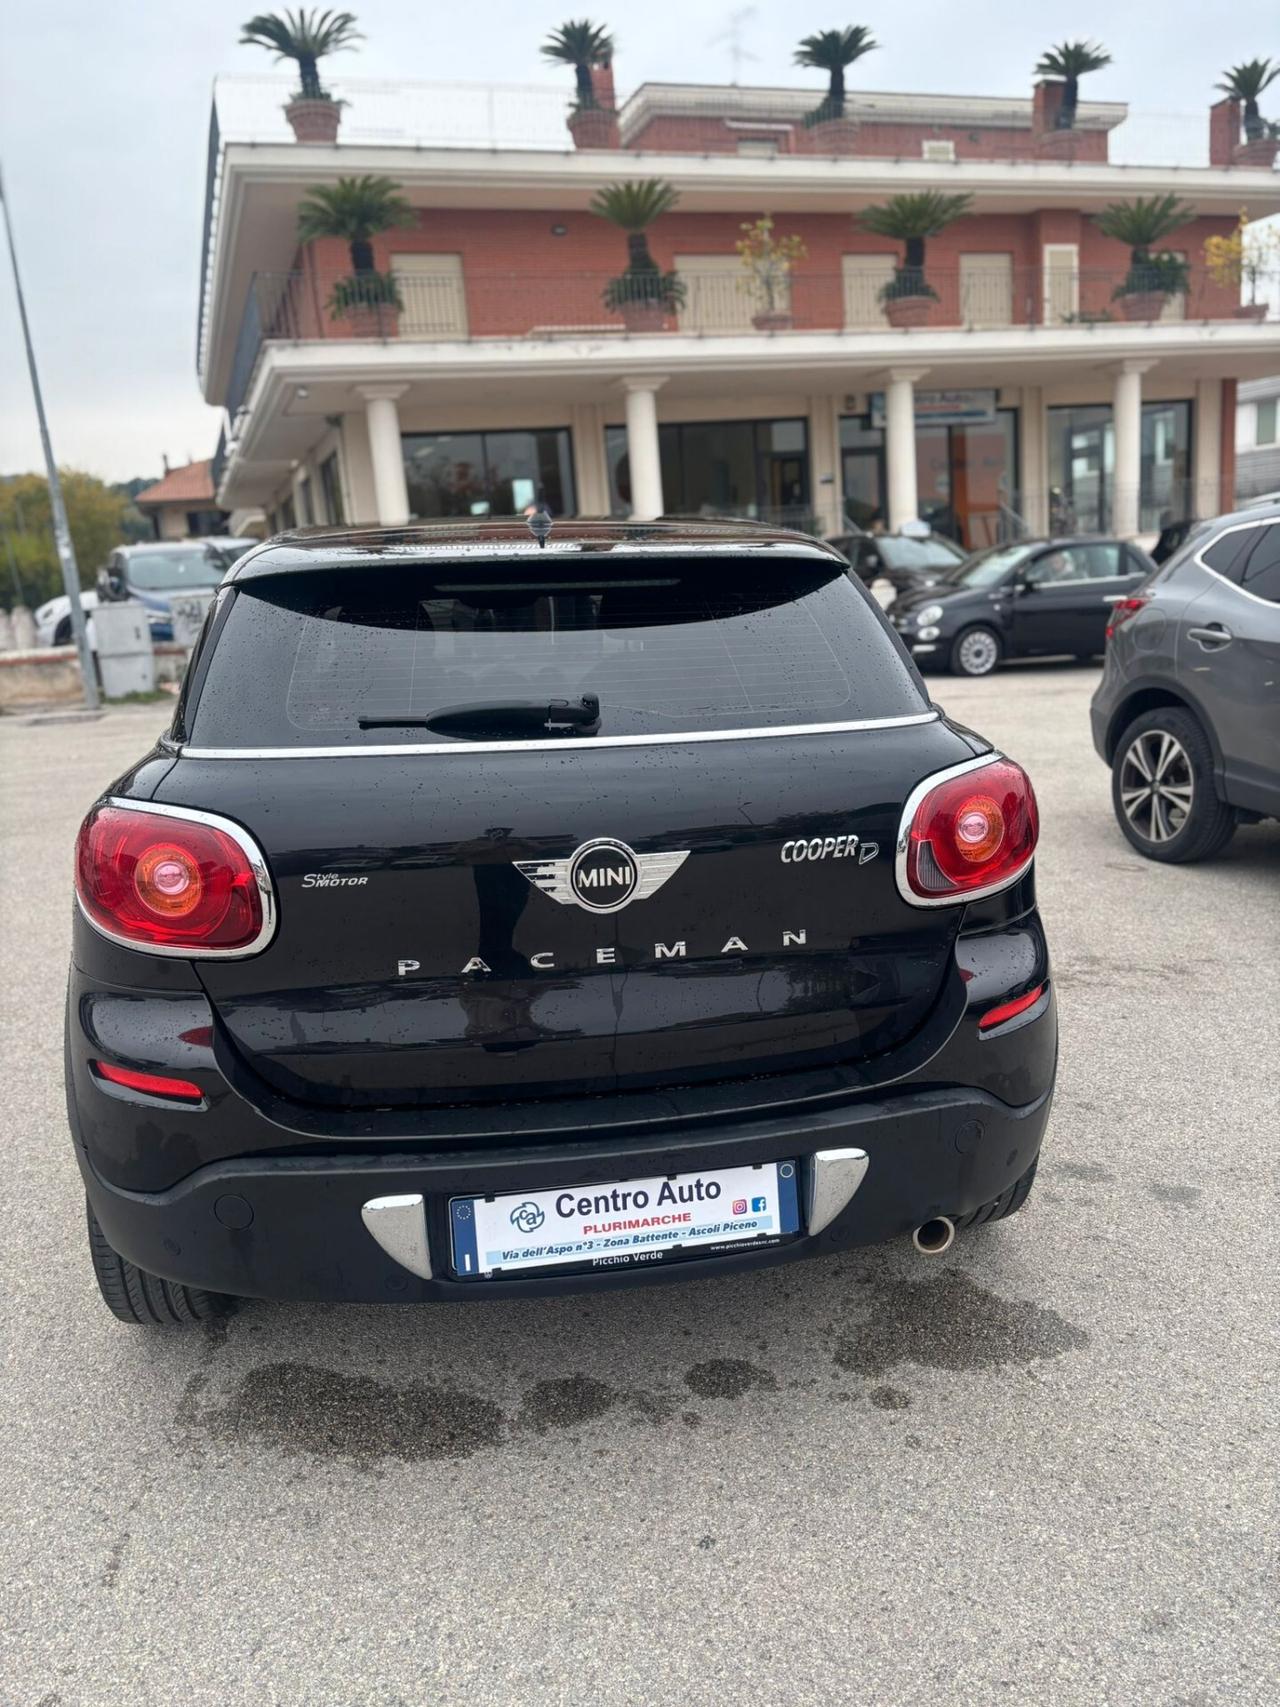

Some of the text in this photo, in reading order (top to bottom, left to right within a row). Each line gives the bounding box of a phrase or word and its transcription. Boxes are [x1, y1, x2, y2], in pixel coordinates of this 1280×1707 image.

[781, 834, 880, 865] COOPER D
[577, 866, 631, 888] MINI
[555, 1178, 721, 1218] Centro Auto
[583, 1212, 692, 1235] PLURIMARCHE
[502, 1249, 519, 1260] Via
[603, 1236, 630, 1248] Zona
[632, 1230, 680, 1244] Battente
[688, 1223, 721, 1237] Ascoli
[723, 1219, 758, 1232] Piceno
[592, 1250, 664, 1266] Picchio Verde
